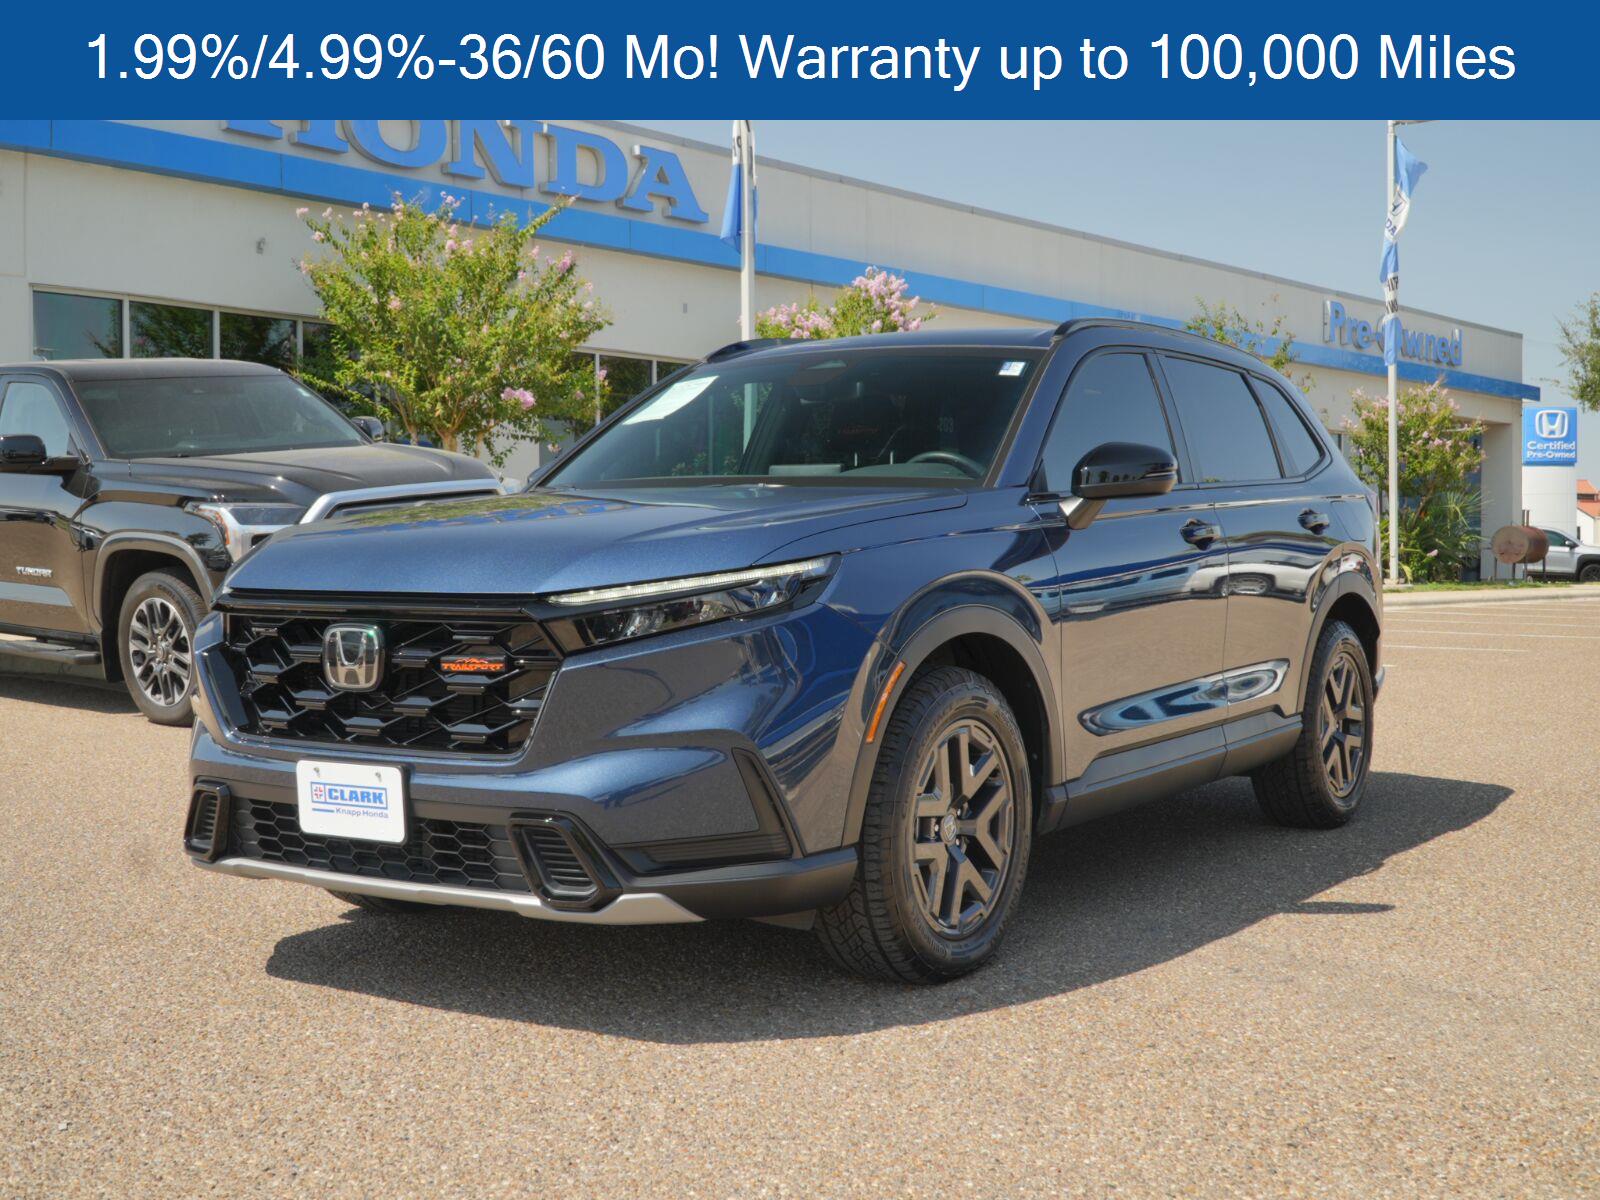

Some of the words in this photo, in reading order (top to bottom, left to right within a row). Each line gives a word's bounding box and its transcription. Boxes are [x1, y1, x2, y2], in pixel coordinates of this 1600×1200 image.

[1527, 440, 1576, 450] Certified
[1527, 450, 1576, 459] Pre-Owned
[15, 566, 53, 578] TUNDRA
[328, 788, 384, 804] CLARK
[335, 807, 361, 817] Knapp
[362, 809, 389, 819] Honda
